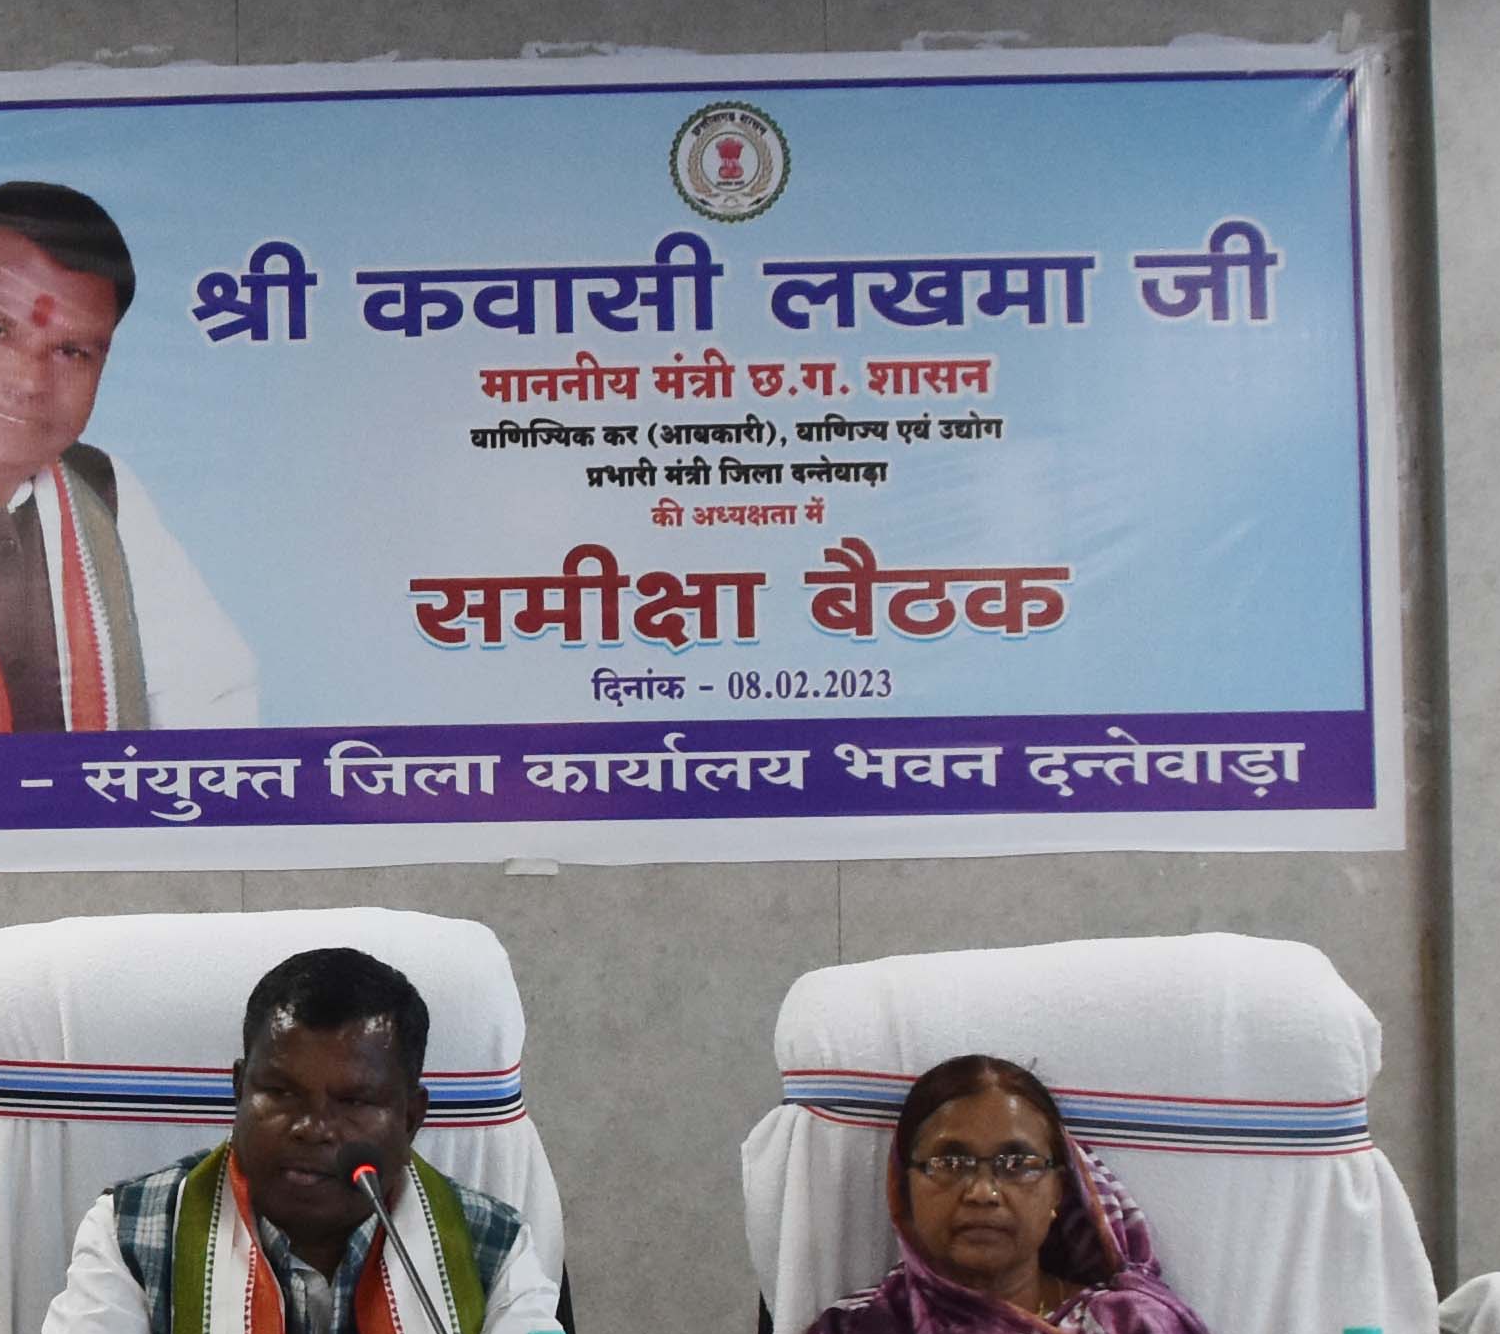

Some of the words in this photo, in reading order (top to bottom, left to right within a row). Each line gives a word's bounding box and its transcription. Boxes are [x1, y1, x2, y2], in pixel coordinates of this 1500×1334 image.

[192, 241, 317, 342] श्री
[356, 231, 724, 337] कवासी
[762, 255, 1095, 330] लखमा
[1134, 220, 1278, 320] जी
[480, 351, 639, 403] माननीय
[653, 348, 735, 399] मंत्री
[748, 362, 849, 398] छ.ग.
[868, 359, 991, 396] शासन
[471, 418, 595, 449] वाणिज्यिक
[604, 424, 637, 446] कर
[797, 414, 888, 444] वाणिज्य
[897, 413, 931, 443] एवं
[938, 411, 1002, 440] उद्योग
[587, 457, 656, 489] प्रभारी
[665, 458, 711, 486] मंत्री
[718, 457, 783, 486] जिला
[791, 455, 888, 488] दन्तेवाड़ा
[651, 498, 684, 528] की
[693, 503, 797, 527] अध्यक्षता
[805, 496, 825, 526] में
[409, 543, 766, 648] समीक्षा
[805, 536, 1070, 637] बैठक
[591, 667, 685, 707] दिनांक
[727, 669, 893, 701] 08.02.2023
[83, 743, 301, 822] संयुक्त
[324, 739, 501, 797] जिला
[523, 732, 809, 794] कार्यालय
[833, 743, 1004, 788] भवन
[1026, 727, 1305, 798] दन्तेवाड़ा
